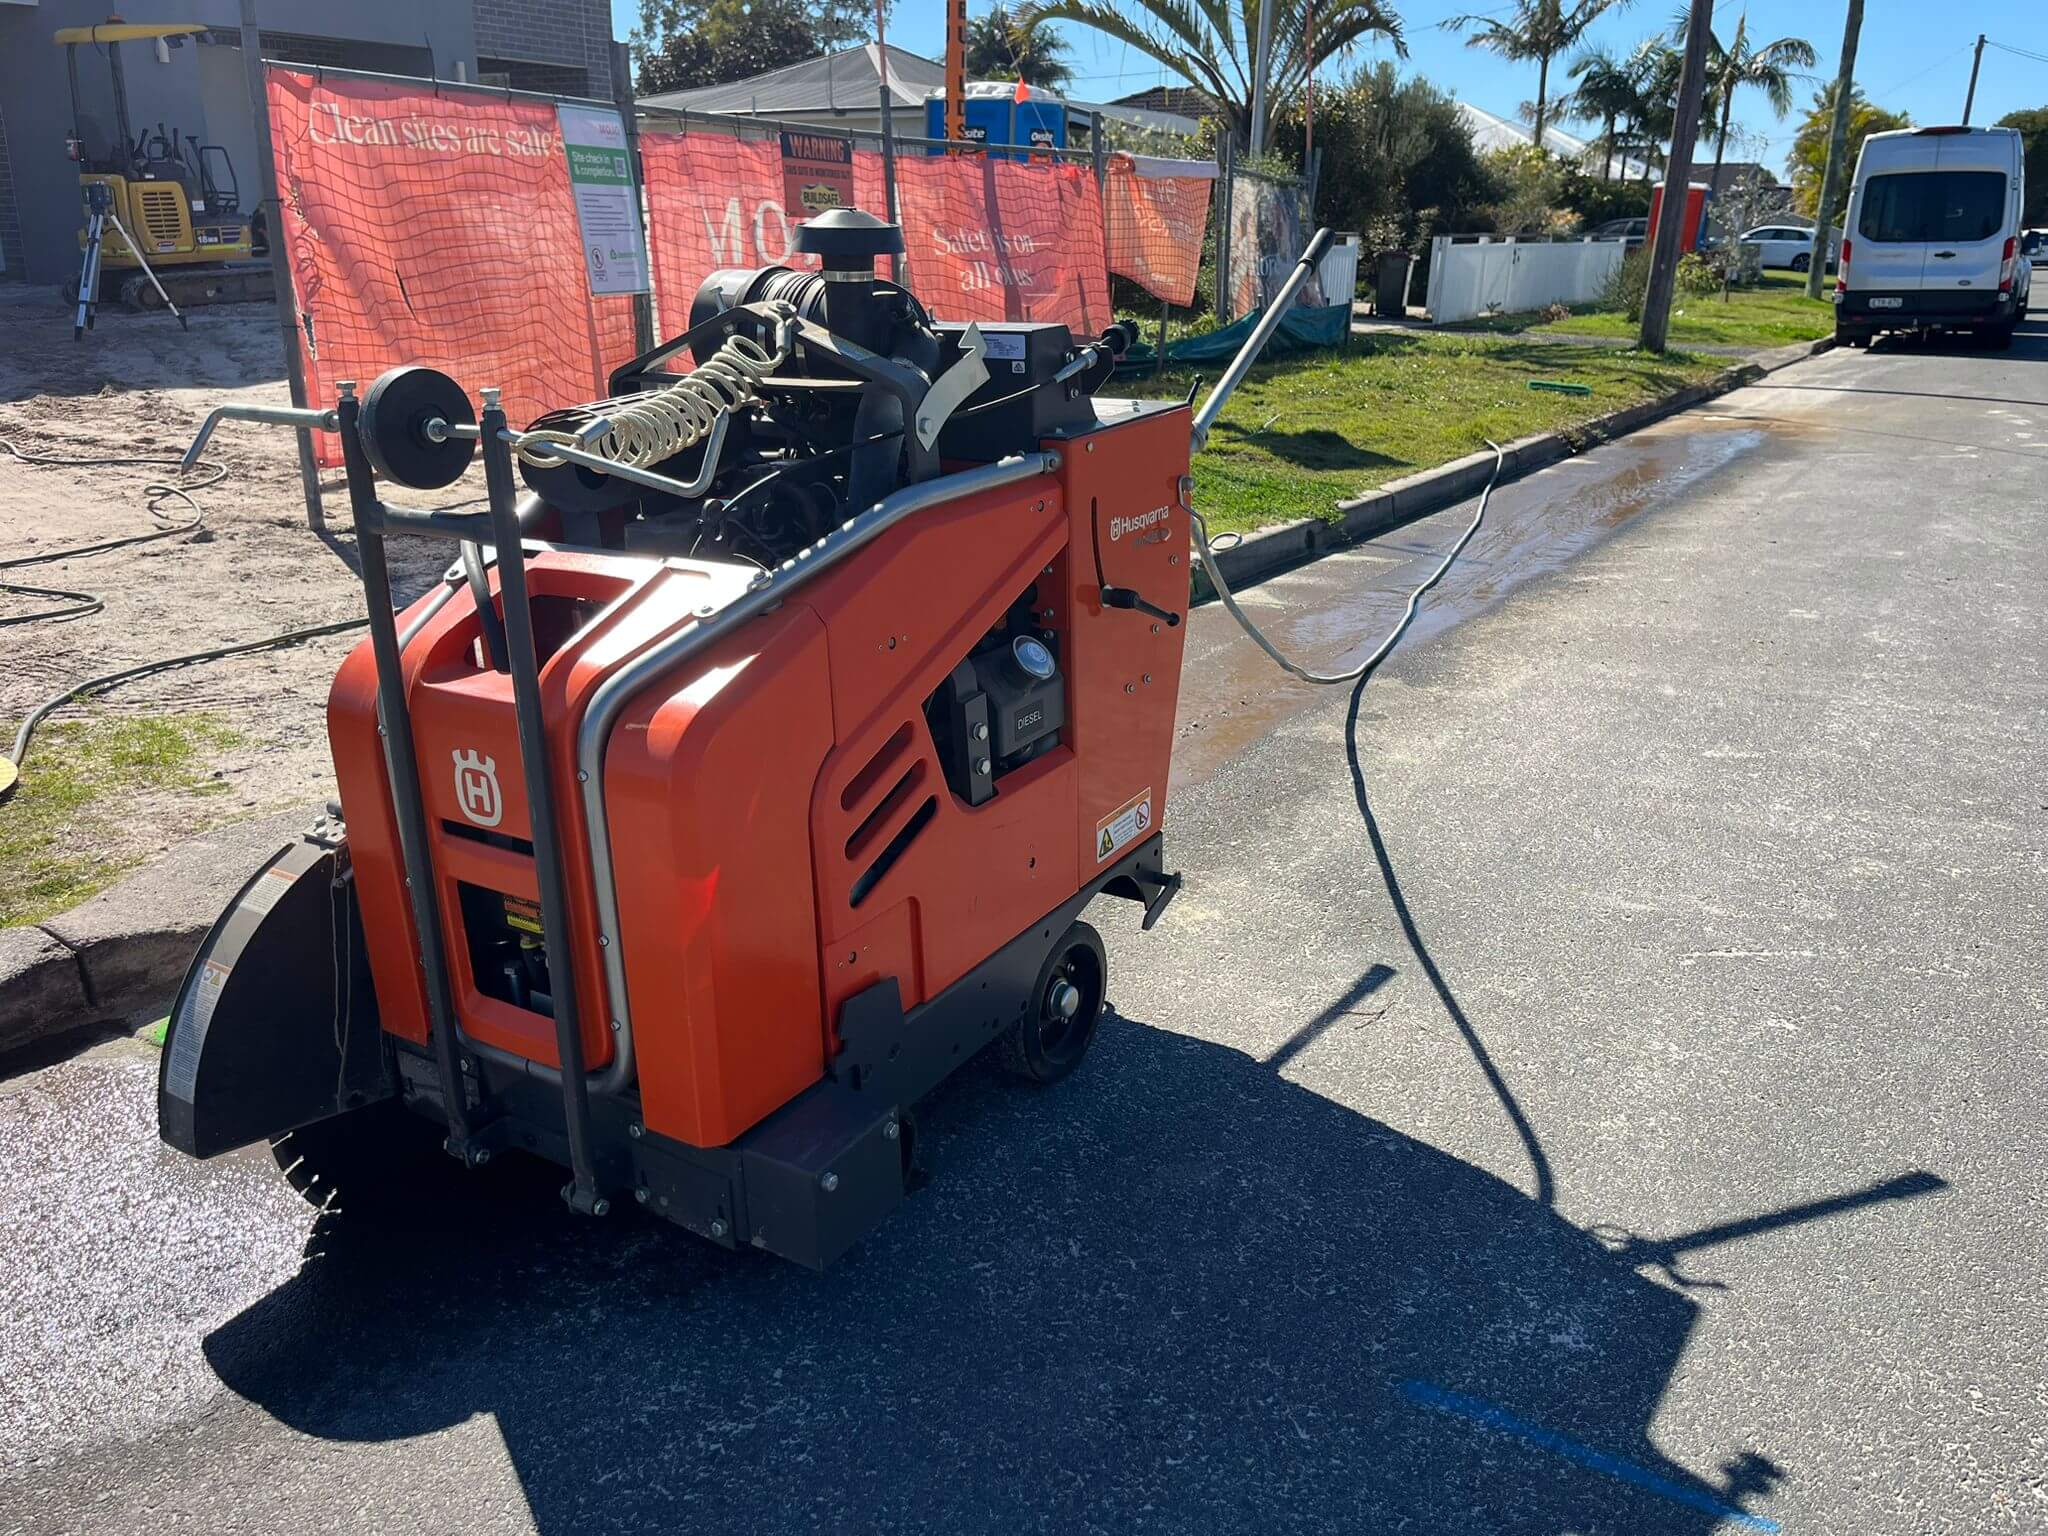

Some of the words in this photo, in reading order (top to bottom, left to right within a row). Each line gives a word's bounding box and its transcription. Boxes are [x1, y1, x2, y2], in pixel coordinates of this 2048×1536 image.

[309, 102, 398, 145] Clean
[401, 112, 462, 153] sites
[465, 125, 501, 156] are
[789, 134, 845, 162] WARNING
[803, 191, 839, 206] BUILDSAFE
[993, 228, 1011, 253] is
[1014, 234, 1035, 253] on
[960, 261, 991, 291] all
[994, 260, 1014, 286] of
[1012, 267, 1034, 287] us
[1121, 505, 1169, 535] Husqvarna
[1017, 710, 1042, 730] DIESEL
